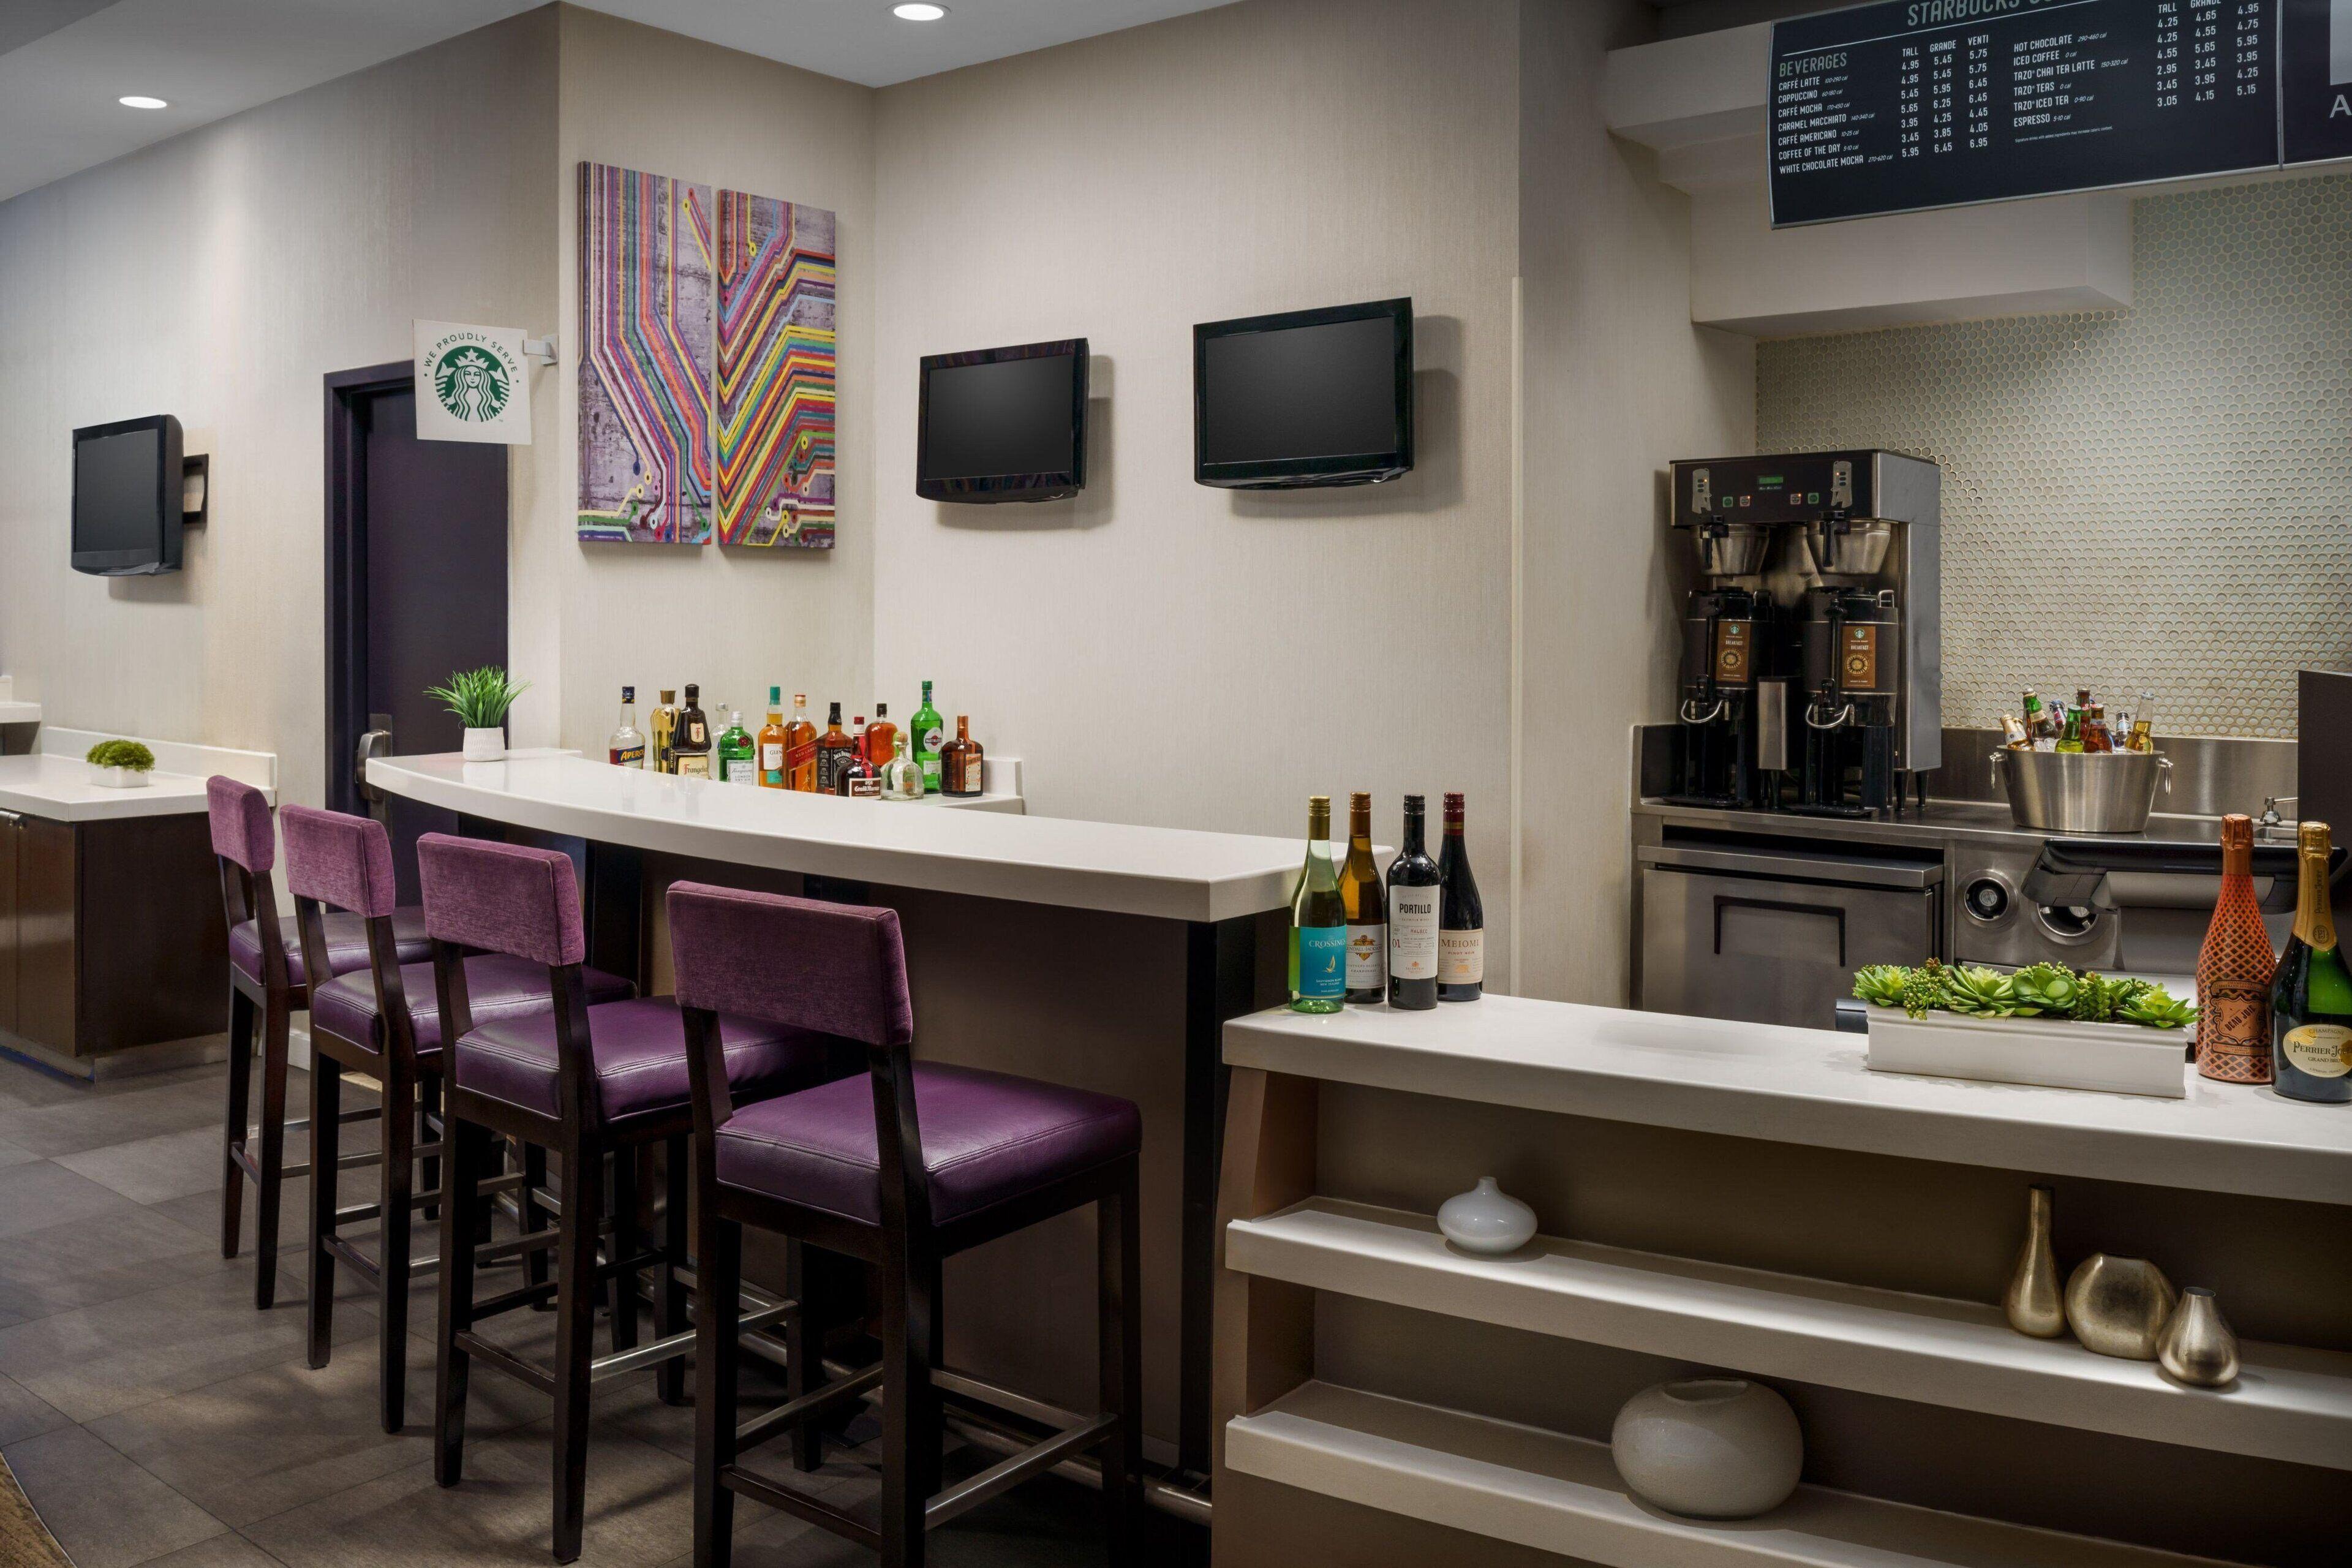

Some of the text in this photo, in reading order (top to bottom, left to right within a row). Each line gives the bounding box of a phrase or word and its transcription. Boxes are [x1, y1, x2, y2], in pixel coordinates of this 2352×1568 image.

[2158, 2, 2177, 13] TALL
[2158, 2, 2259, 28] 4.25 4.65 4.95
[2157, 18, 2259, 43] 4.25 4.55 4.75
[1902, 34, 1989, 57] TALL GRANDE VENTI
[2014, 41, 2028, 53] HOT
[2030, 34, 2073, 50] CHOCOLATE
[2157, 34, 2258, 59] 4.55 5.65 5.95
[1779, 52, 1847, 77] BEVERAGES
[1902, 48, 1988, 70] 4.95 5.45 5.75
[2013, 55, 2030, 66] ICED
[2032, 50, 2060, 63] COFFEE
[2157, 50, 2258, 75] 2.95 3.45 3.95
[1901, 62, 1987, 85] 4.95 5.45 5.75
[2036, 67, 2053, 78] CHAI
[2056, 64, 2070, 75] TEA
[2071, 59, 2095, 72] LATTE
[1779, 78, 1798, 91] CAFFÉ
[1800, 77, 1820, 88] LATTE
[1901, 77, 1988, 99] 5.45 5.95 6.45
[2036, 81, 2055, 93] TEAS
[2157, 67, 2258, 91] 3.45 3.95 4.25
[1778, 90, 1818, 104] CAPPUCCINO
[1901, 92, 1988, 114] 5.65 6.25 6.45
[2036, 97, 2052, 109] ICED
[2055, 95, 2069, 106] TEA
[2157, 83, 2256, 107] 3.05 4.15 5.15
[1778, 105, 1798, 118] CAFFÉ
[1800, 103, 1823, 115] MOCHA
[1901, 107, 1988, 128] 3.95 4.25 4.45
[2013, 113, 2051, 127] ESPRESSO
[1778, 119, 1807, 132] CARAMEL
[1810, 113, 1847, 127] MACCHIATO
[1901, 122, 1988, 143] 3.45 3.85 4.05
[1778, 133, 1798, 146] CAFFÉ
[1800, 129, 1837, 143] AMERICANO
[1902, 137, 1988, 157] 5.95 6.45 6.95
[1779, 148, 1803, 160] COFFEE
[1804, 148, 1812, 157] OF
[1814, 145, 1826, 155] THE
[1828, 143, 1841, 153] DAY
[1779, 163, 1800, 175] WHITE
[1802, 158, 1838, 172] CHOCOLATE
[1841, 154, 1863, 166] MOCHA
[424, 332, 517, 372] WE PROUDLY SERVE
[1399, 903, 1431, 914] PORTILLO
[1441, 939, 1479, 948] MEIOMI
